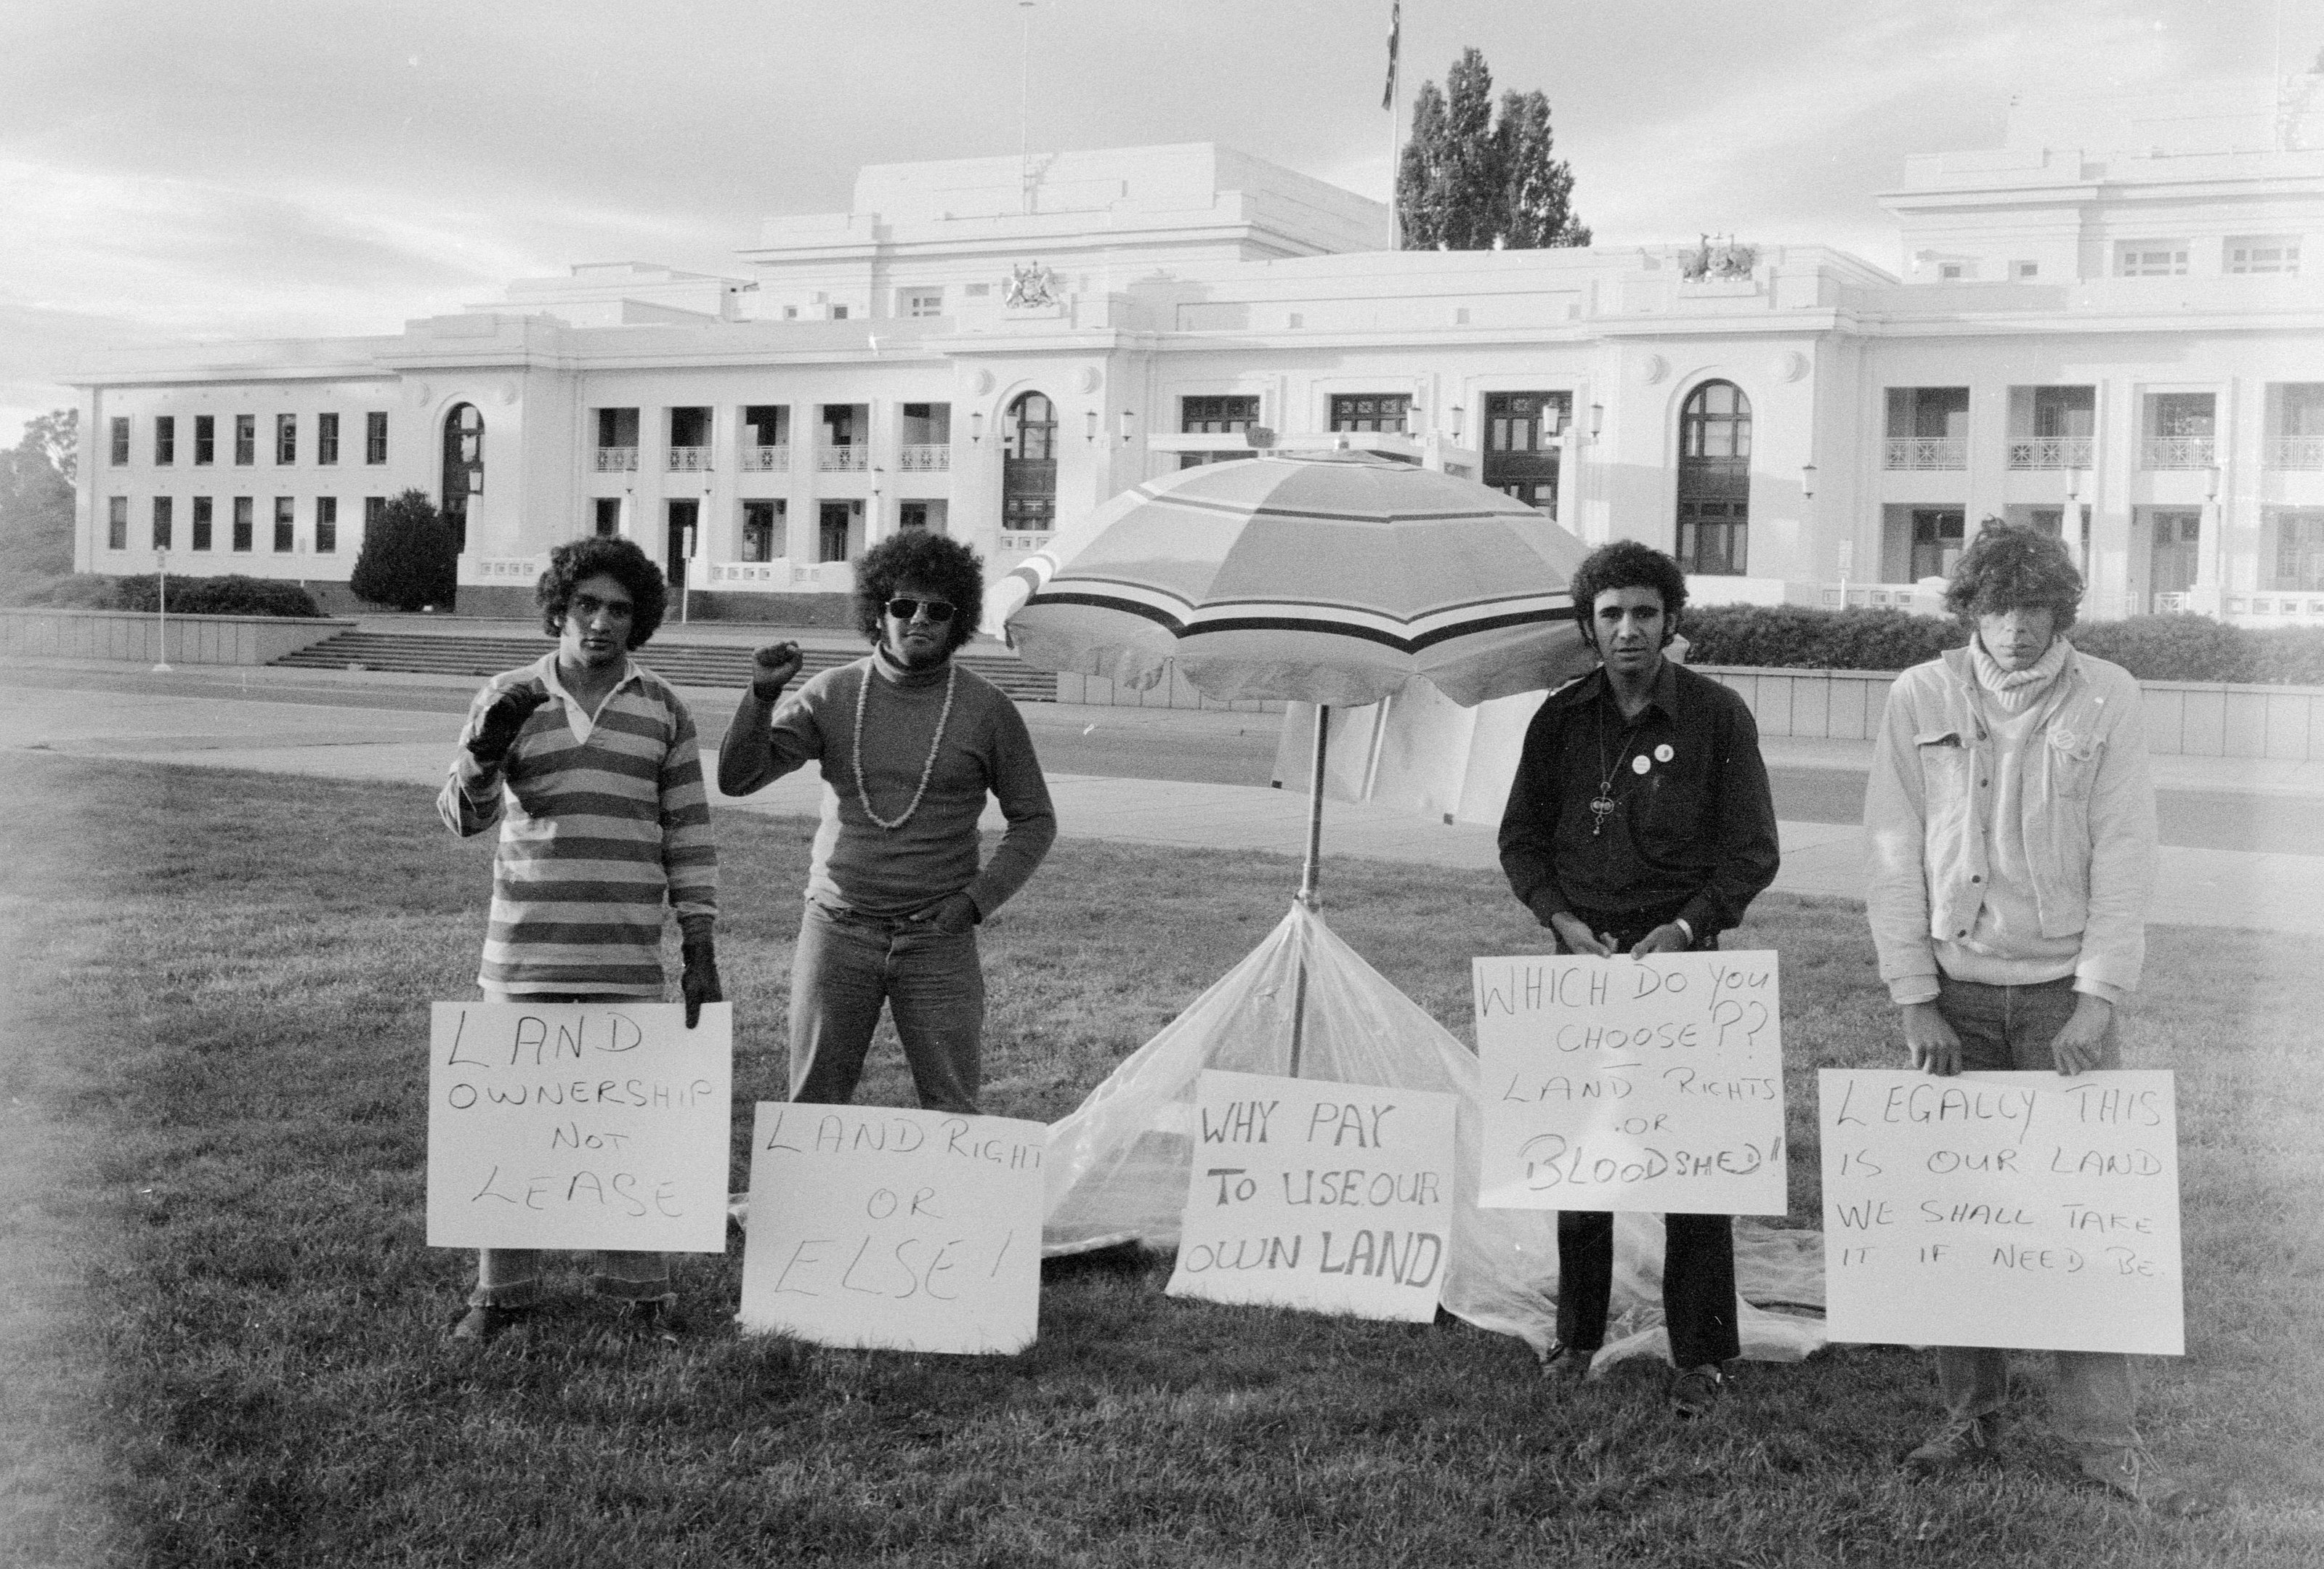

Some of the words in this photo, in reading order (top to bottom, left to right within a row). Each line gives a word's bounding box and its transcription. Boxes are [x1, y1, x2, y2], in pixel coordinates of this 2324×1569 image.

[1480, 965, 1608, 1017] WHICH
[1632, 963, 1688, 1000] DO
[1708, 962, 1769, 1010] YOU
[448, 1010, 641, 1067] LAND
[448, 1079, 712, 1109] OWNERSHIP
[1502, 1073, 1632, 1103] LAND
[1663, 1066, 1776, 1100] RIGHTS
[1202, 1100, 1279, 1143] WHY
[1307, 1102, 1396, 1148] PAY
[1837, 1079, 2036, 1145] LEGALLY
[2065, 1083, 2161, 1127] THIS
[766, 1110, 924, 1153] LAND
[940, 1117, 1042, 1169] RIGHT
[1840, 1148, 1882, 1177] IS
[1927, 1148, 2019, 1174] OUR
[2051, 1146, 2162, 1177] LAND
[471, 1165, 683, 1217] LEASE
[867, 1187, 944, 1220] OR
[1837, 1199, 1895, 1231] WE
[1921, 1199, 2033, 1225] SHALL
[2062, 1203, 2153, 1234] TAKE
[1186, 1234, 1302, 1273] OWN
[1319, 1229, 1443, 1288] LAND
[1843, 1246, 1875, 1266] IT
[1919, 1244, 1951, 1263] IF
[1992, 1244, 2084, 1273] NEED
